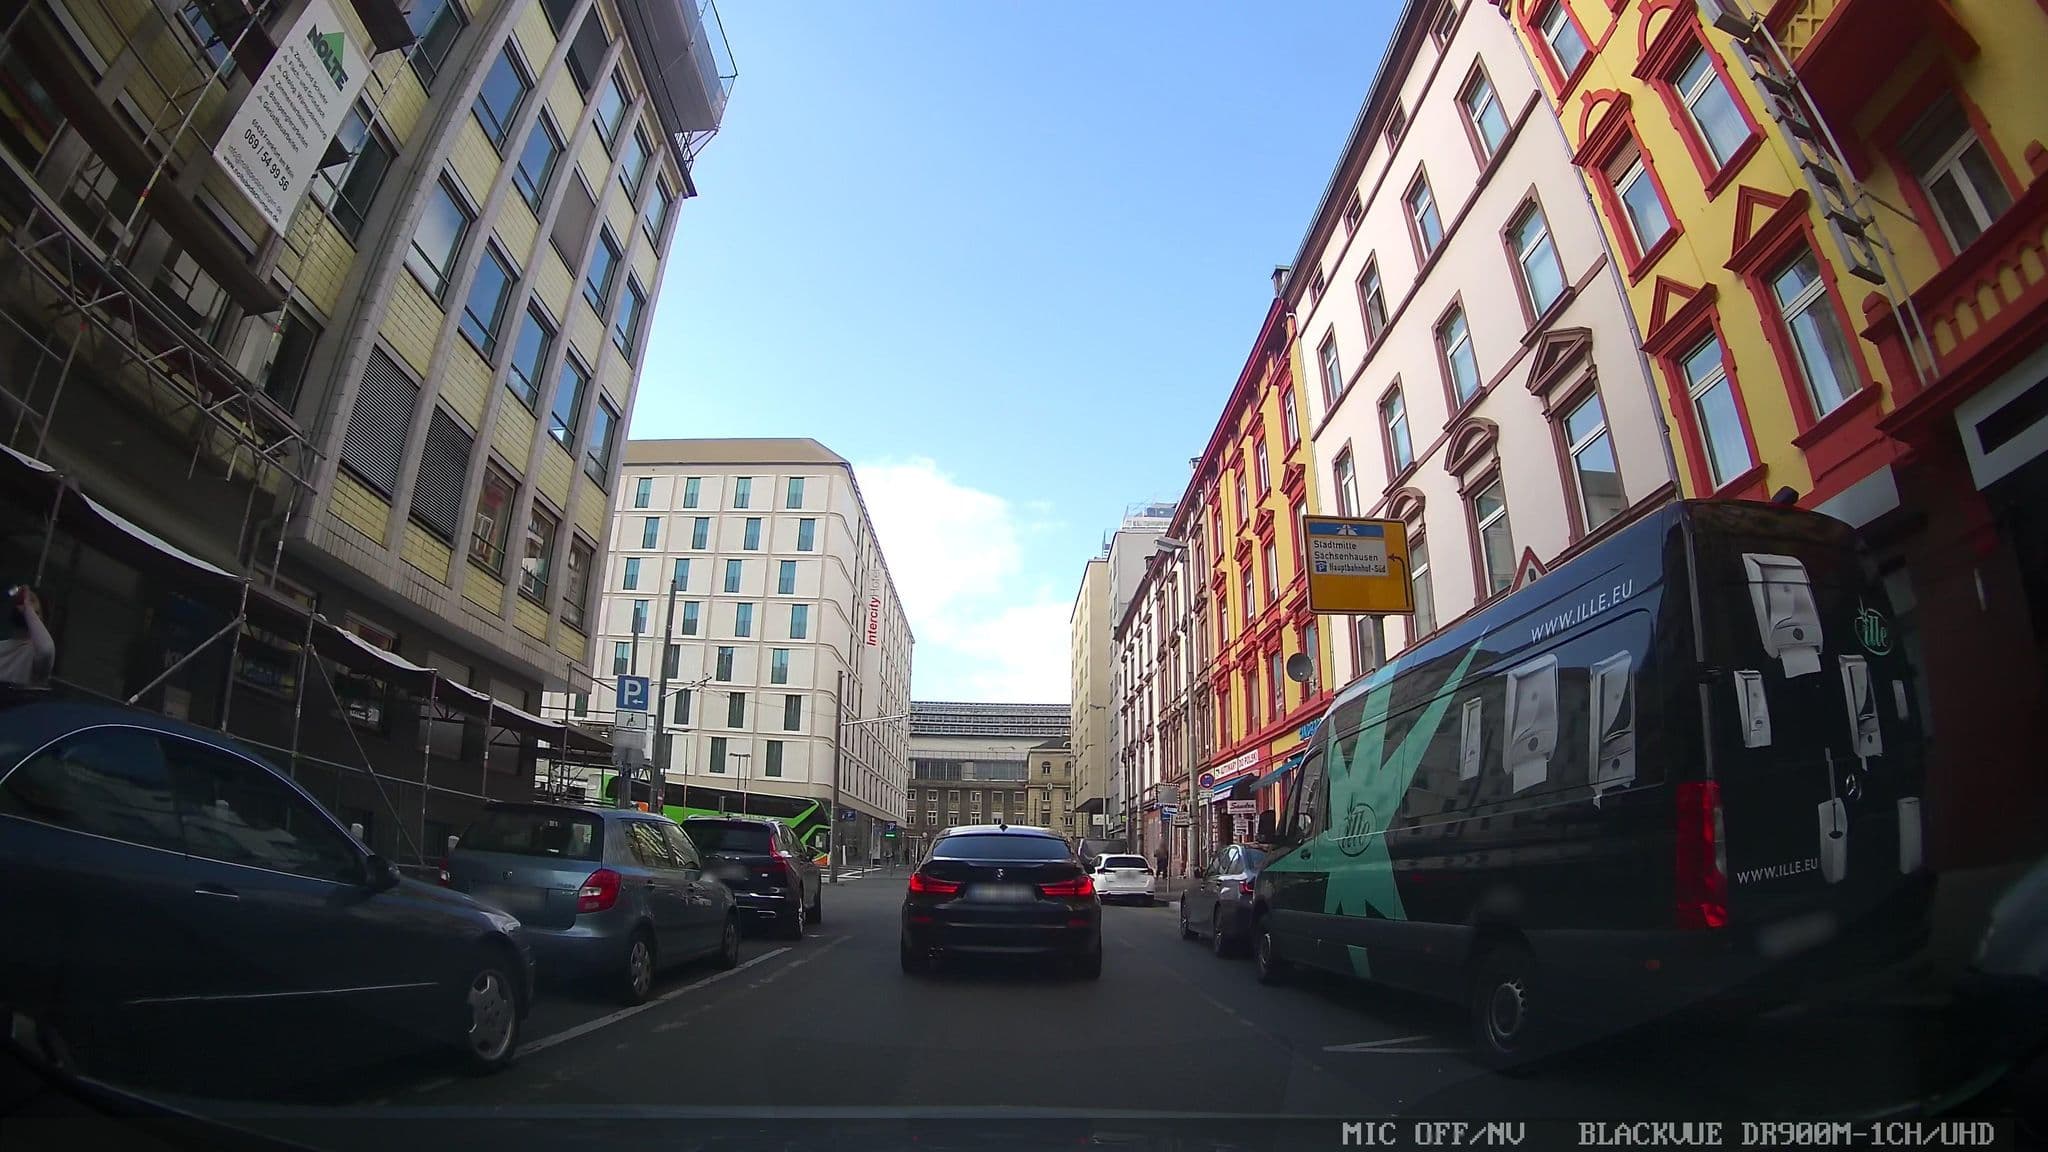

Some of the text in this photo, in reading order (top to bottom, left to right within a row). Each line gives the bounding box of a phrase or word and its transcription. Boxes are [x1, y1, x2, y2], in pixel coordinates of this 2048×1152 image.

[306, 24, 349, 92] NOLTE
[243, 128, 260, 150] 069
[260, 151, 272, 167] 54
[270, 164, 281, 180] 99
[278, 176, 290, 191] 56
[1313, 539, 1357, 550] Stadtmitte
[1314, 551, 1379, 561] Sachsenhausen
[1531, 579, 1632, 643] WWW.ILLE.EU
[623, 679, 642, 706] P
[1737, 858, 1818, 884] WWW.ILLE.EU
